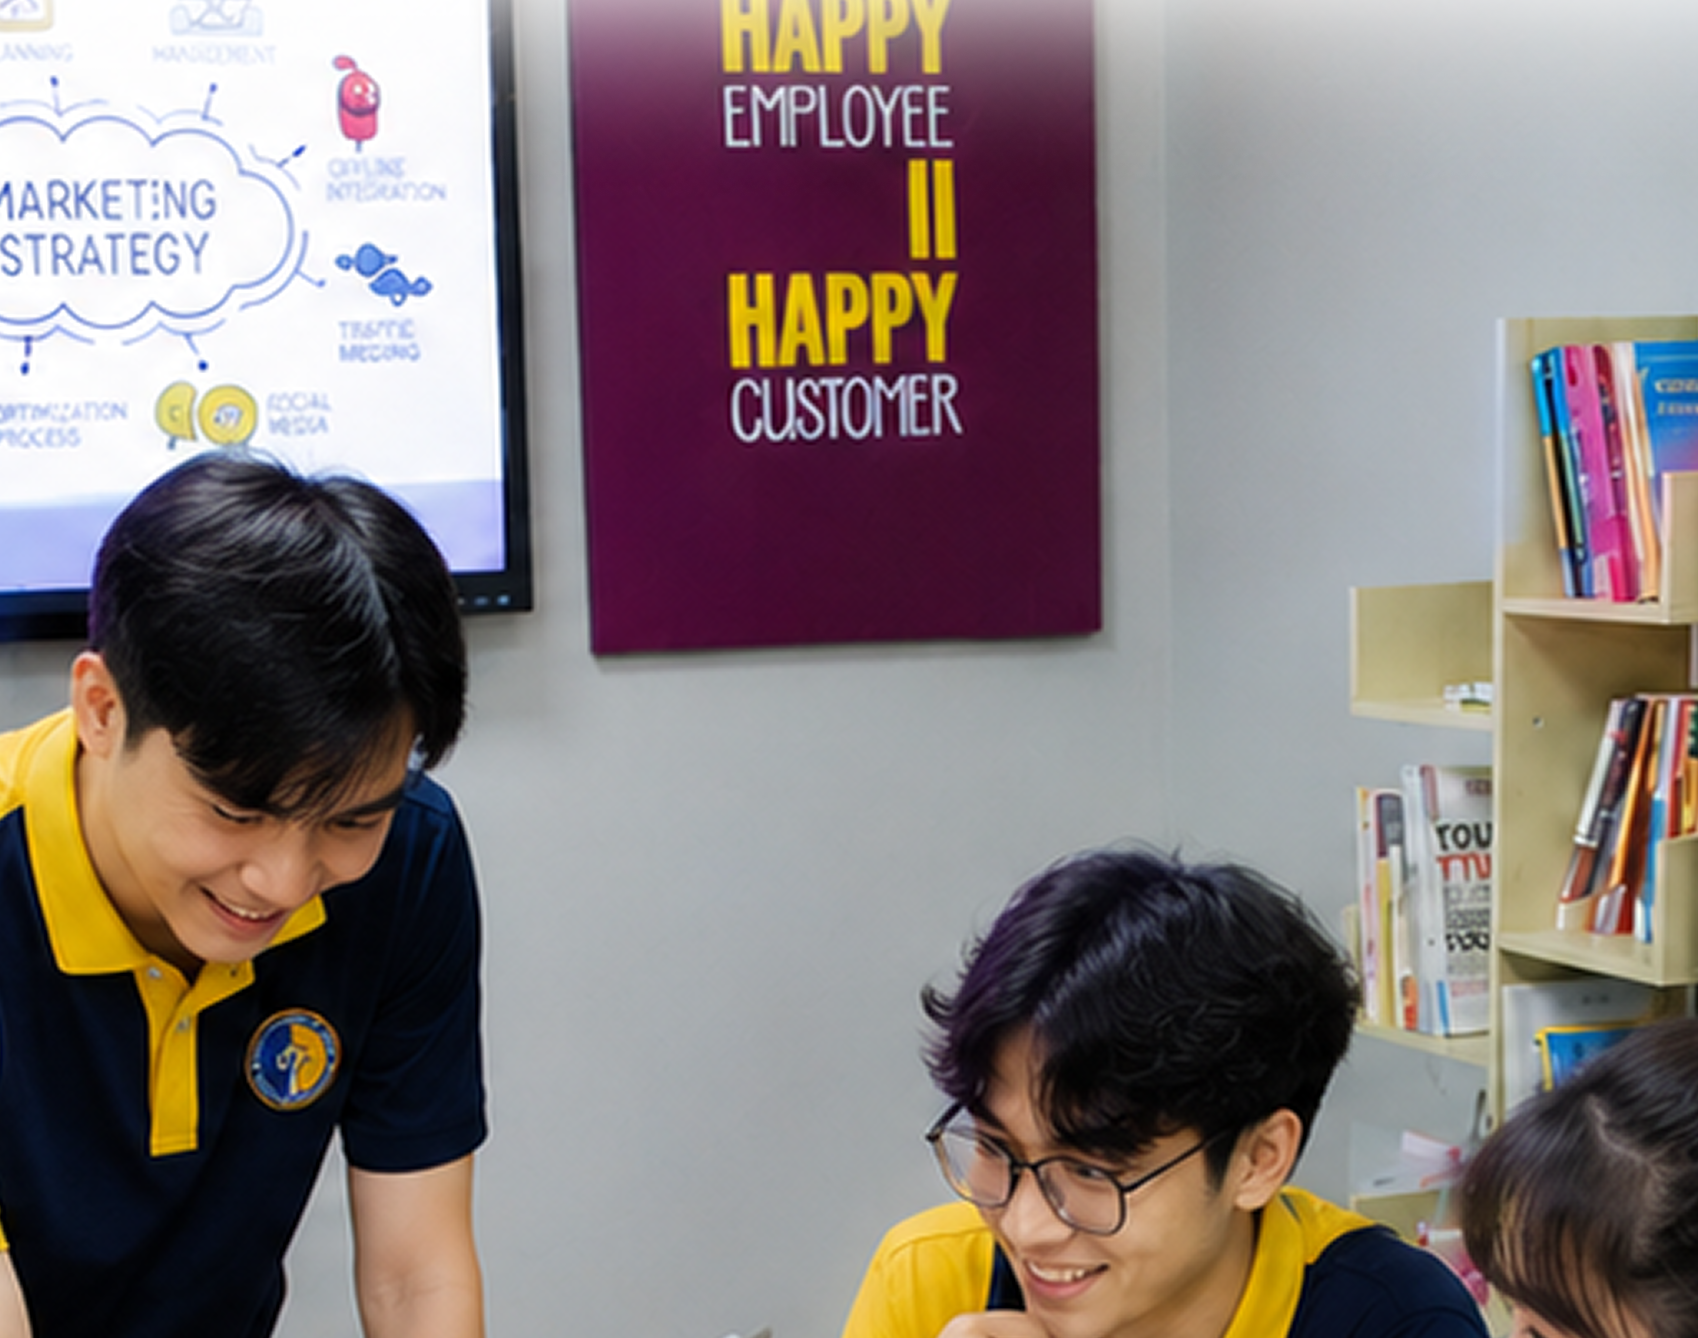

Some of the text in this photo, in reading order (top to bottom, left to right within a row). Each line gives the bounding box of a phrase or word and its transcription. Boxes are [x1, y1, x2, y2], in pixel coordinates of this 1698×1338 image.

[721, 0, 952, 74] HAPPY
[722, 84, 955, 149] EMPLOYEE
[0, 231, 209, 277] STRATEGY
[727, 271, 958, 369] HAPPY
[731, 373, 963, 443] CUSTOMER
